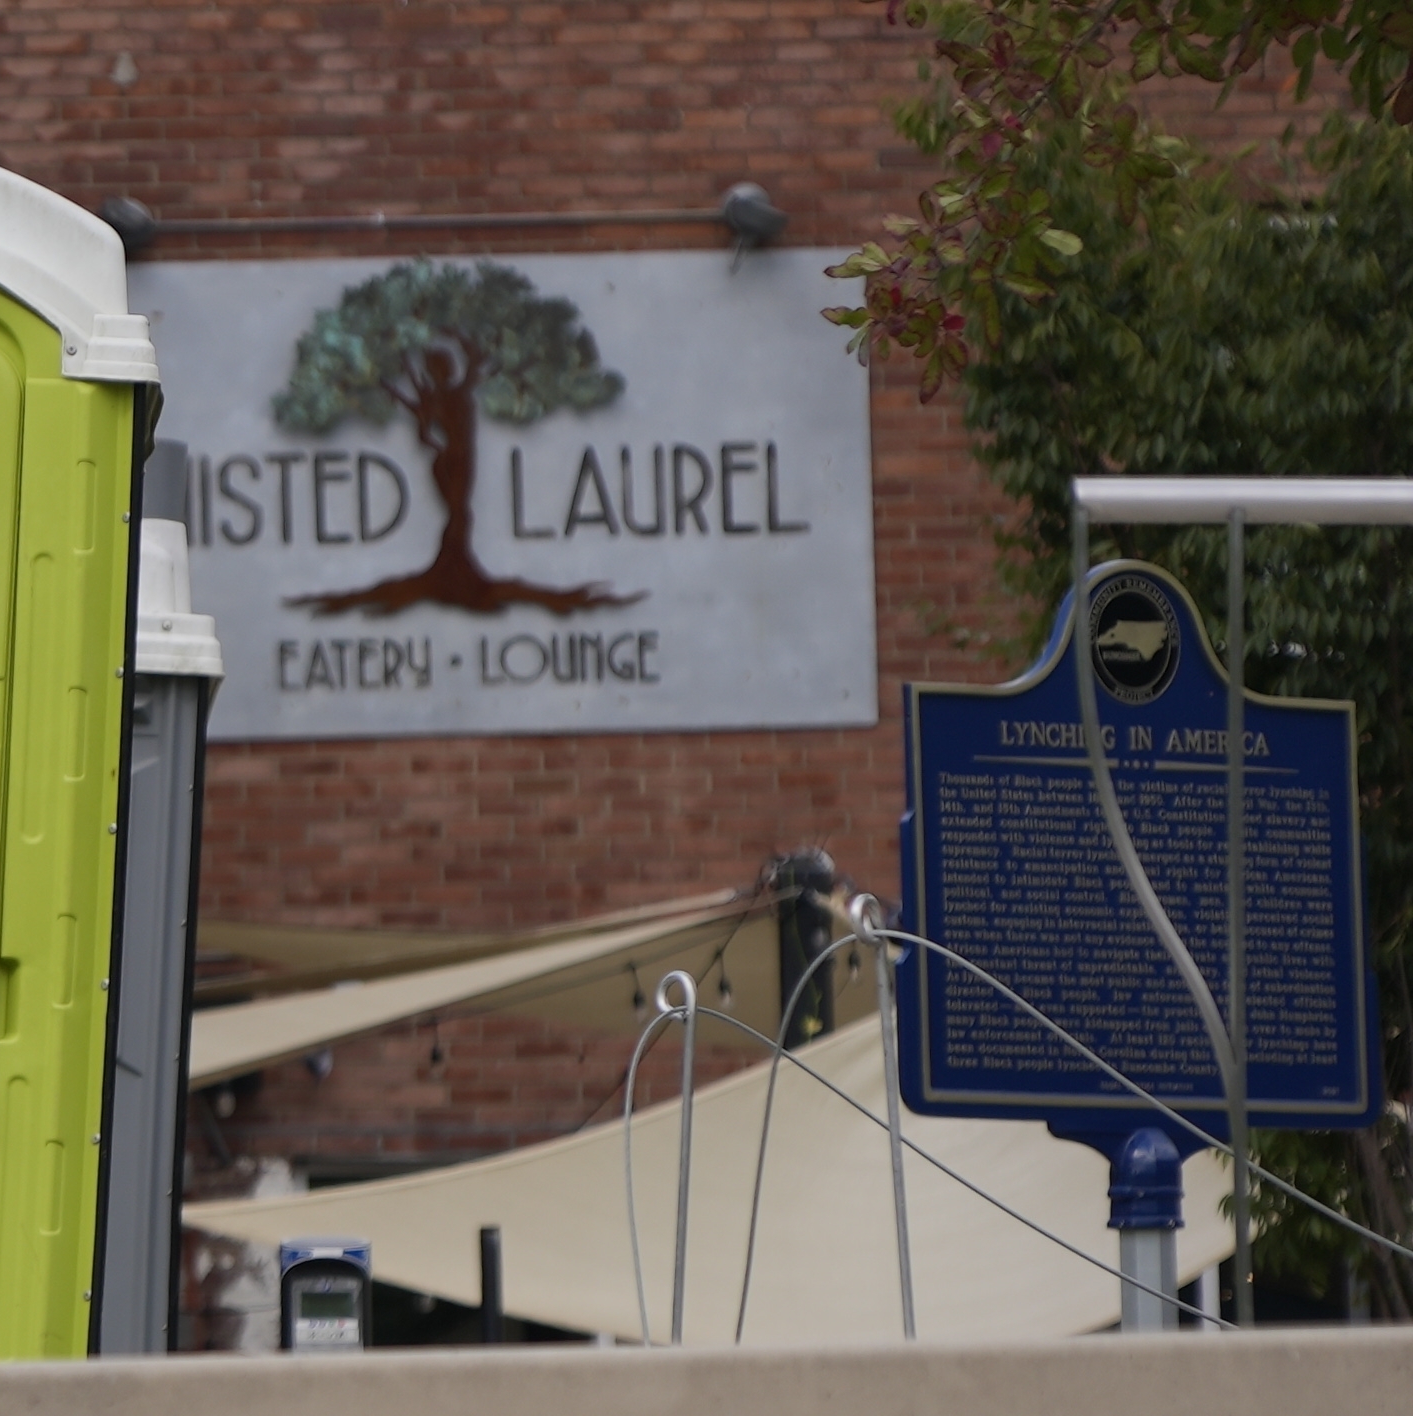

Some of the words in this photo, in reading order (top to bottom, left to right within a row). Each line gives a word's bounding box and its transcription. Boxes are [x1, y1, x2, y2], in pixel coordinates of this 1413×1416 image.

[188, 450, 409, 545] ISTED
[512, 445, 810, 538] LAUREL
[278, 639, 431, 689] EATERY
[480, 632, 660, 683] LOUNGE
[1001, 721, 1115, 751] LYNCHIG
[1130, 726, 1152, 751] IN
[1166, 728, 1269, 757] AMERCA
